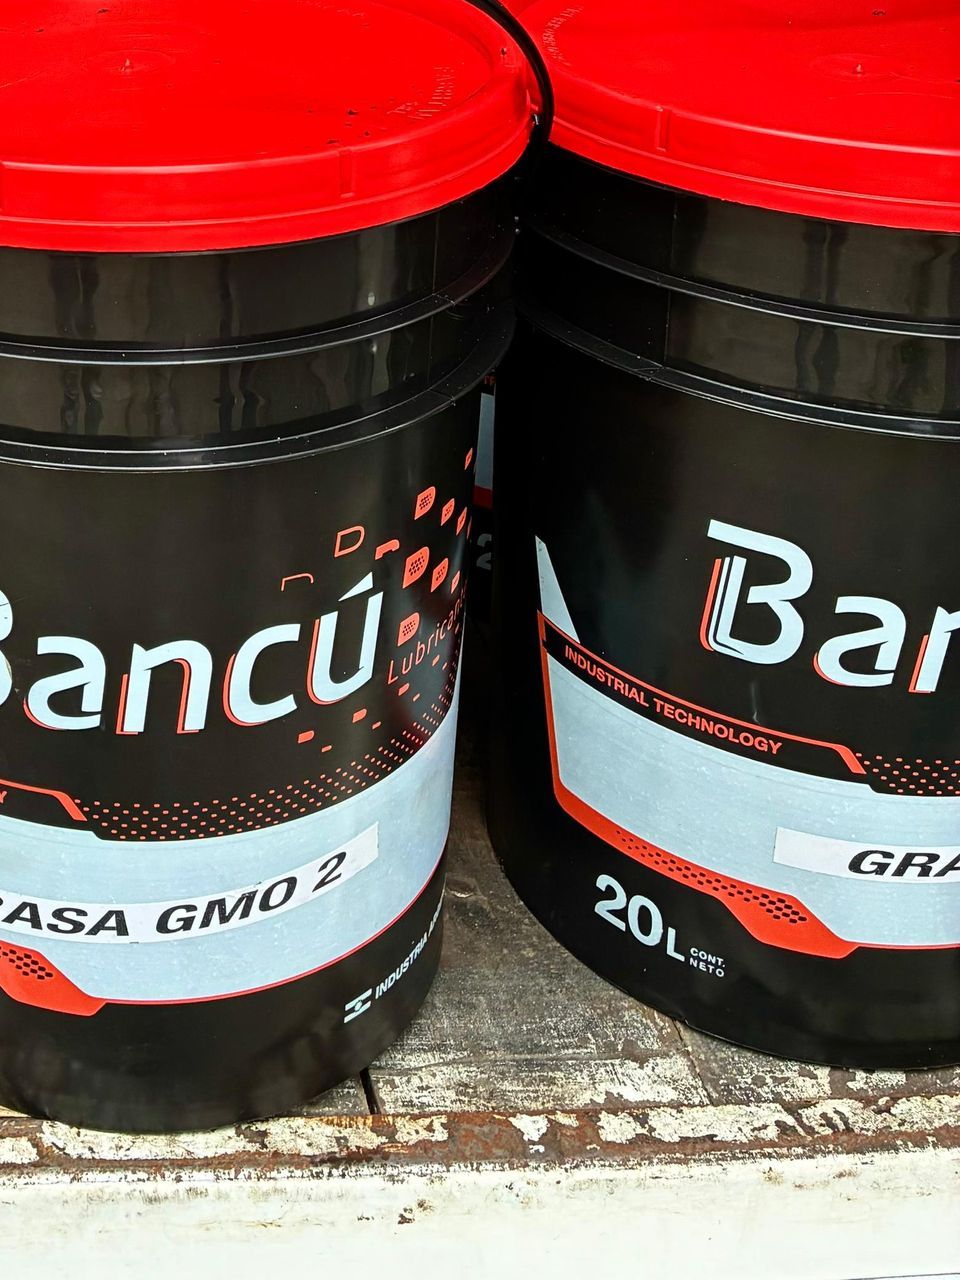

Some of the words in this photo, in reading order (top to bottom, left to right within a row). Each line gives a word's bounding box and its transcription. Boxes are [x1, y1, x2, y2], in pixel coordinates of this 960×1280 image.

[564, 644, 650, 707] INDUSTRIAL
[652, 697, 784, 755] TECHNOLOGY
[155, 875, 298, 935] GMO
[311, 850, 348, 893] 2
[374, 931, 429, 1000] INDUSTRIA
[689, 947, 726, 968] CONT.
[689, 957, 725, 978] NETO
